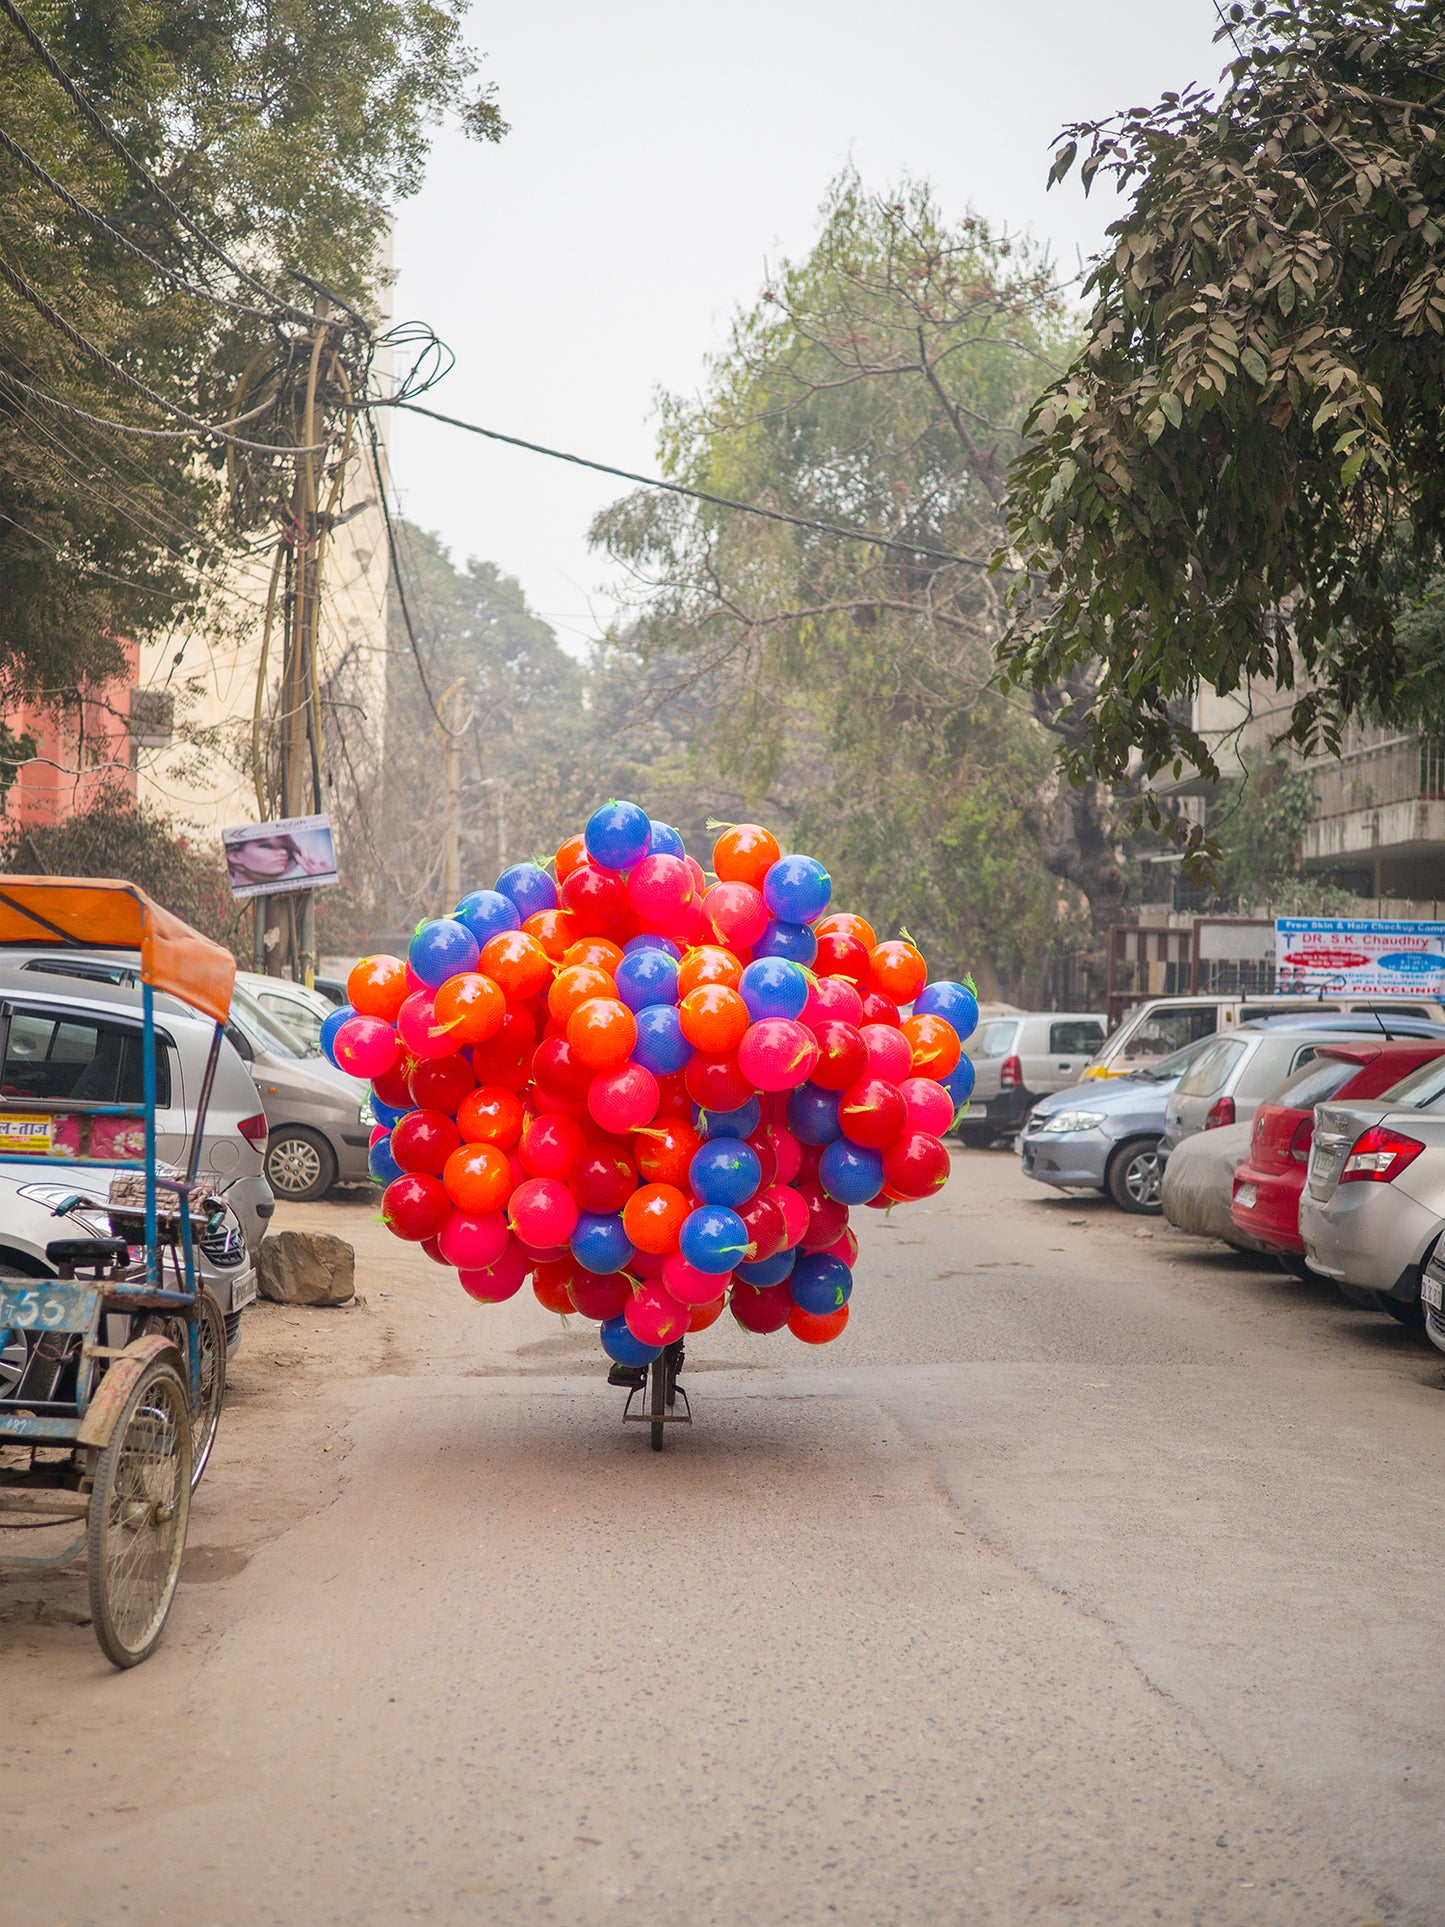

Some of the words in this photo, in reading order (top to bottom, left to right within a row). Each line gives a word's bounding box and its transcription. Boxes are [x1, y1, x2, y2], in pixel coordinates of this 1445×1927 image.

[1285, 921, 1308, 929] Free
[1311, 921, 1333, 930] Skin
[1347, 922, 1368, 931] Hair
[1302, 933, 1326, 944] DR.
[1362, 935, 1429, 951] Chaudhry
[1352, 986, 1441, 994] POLYCLINIC
